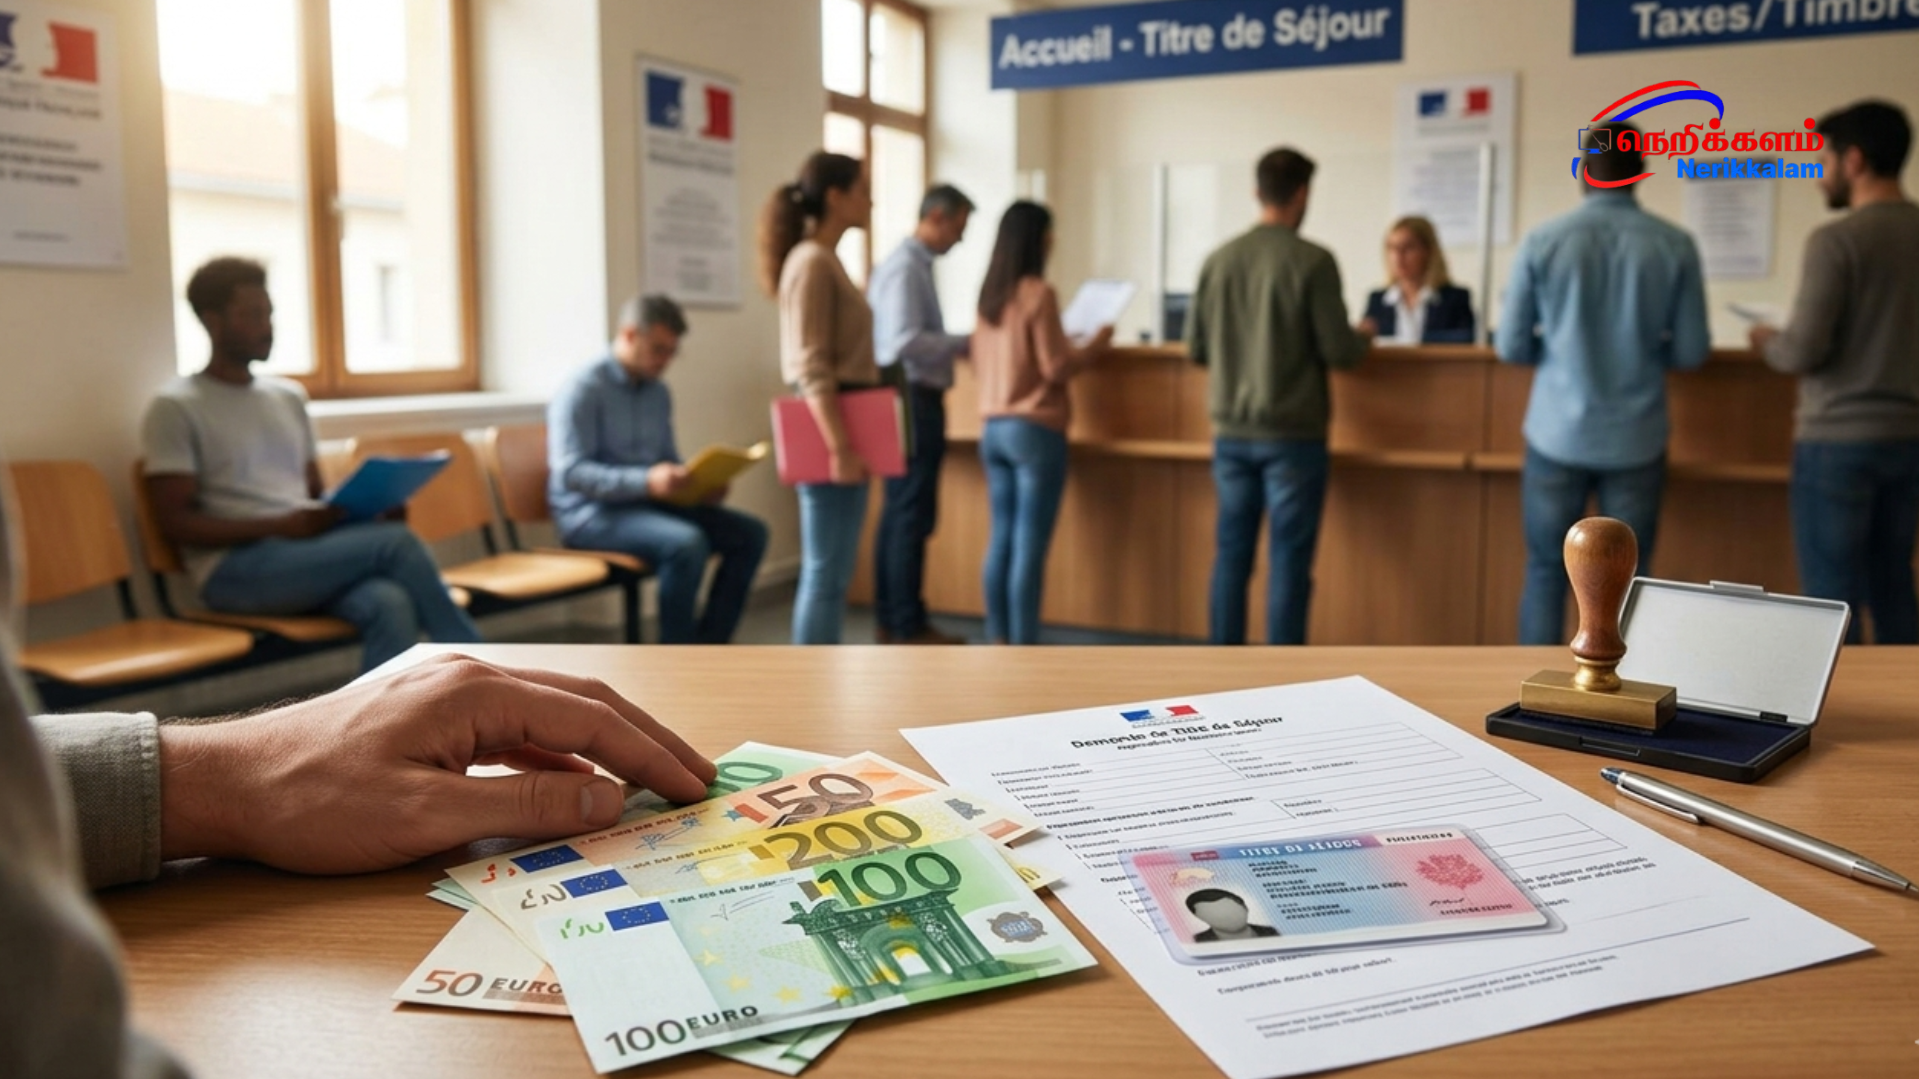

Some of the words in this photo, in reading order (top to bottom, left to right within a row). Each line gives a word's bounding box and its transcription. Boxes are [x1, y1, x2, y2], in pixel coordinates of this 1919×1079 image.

[998, 25, 1113, 70] Accueil
[1139, 20, 1215, 57] Titre
[1222, 13, 1266, 49] de
[1273, 4, 1391, 51] Séjour
[757, 773, 874, 820] 50
[764, 810, 923, 871] 200
[817, 851, 963, 907] 100
[416, 969, 484, 997] 50
[604, 1018, 688, 1056] 100
[685, 1004, 760, 1031] EURO
